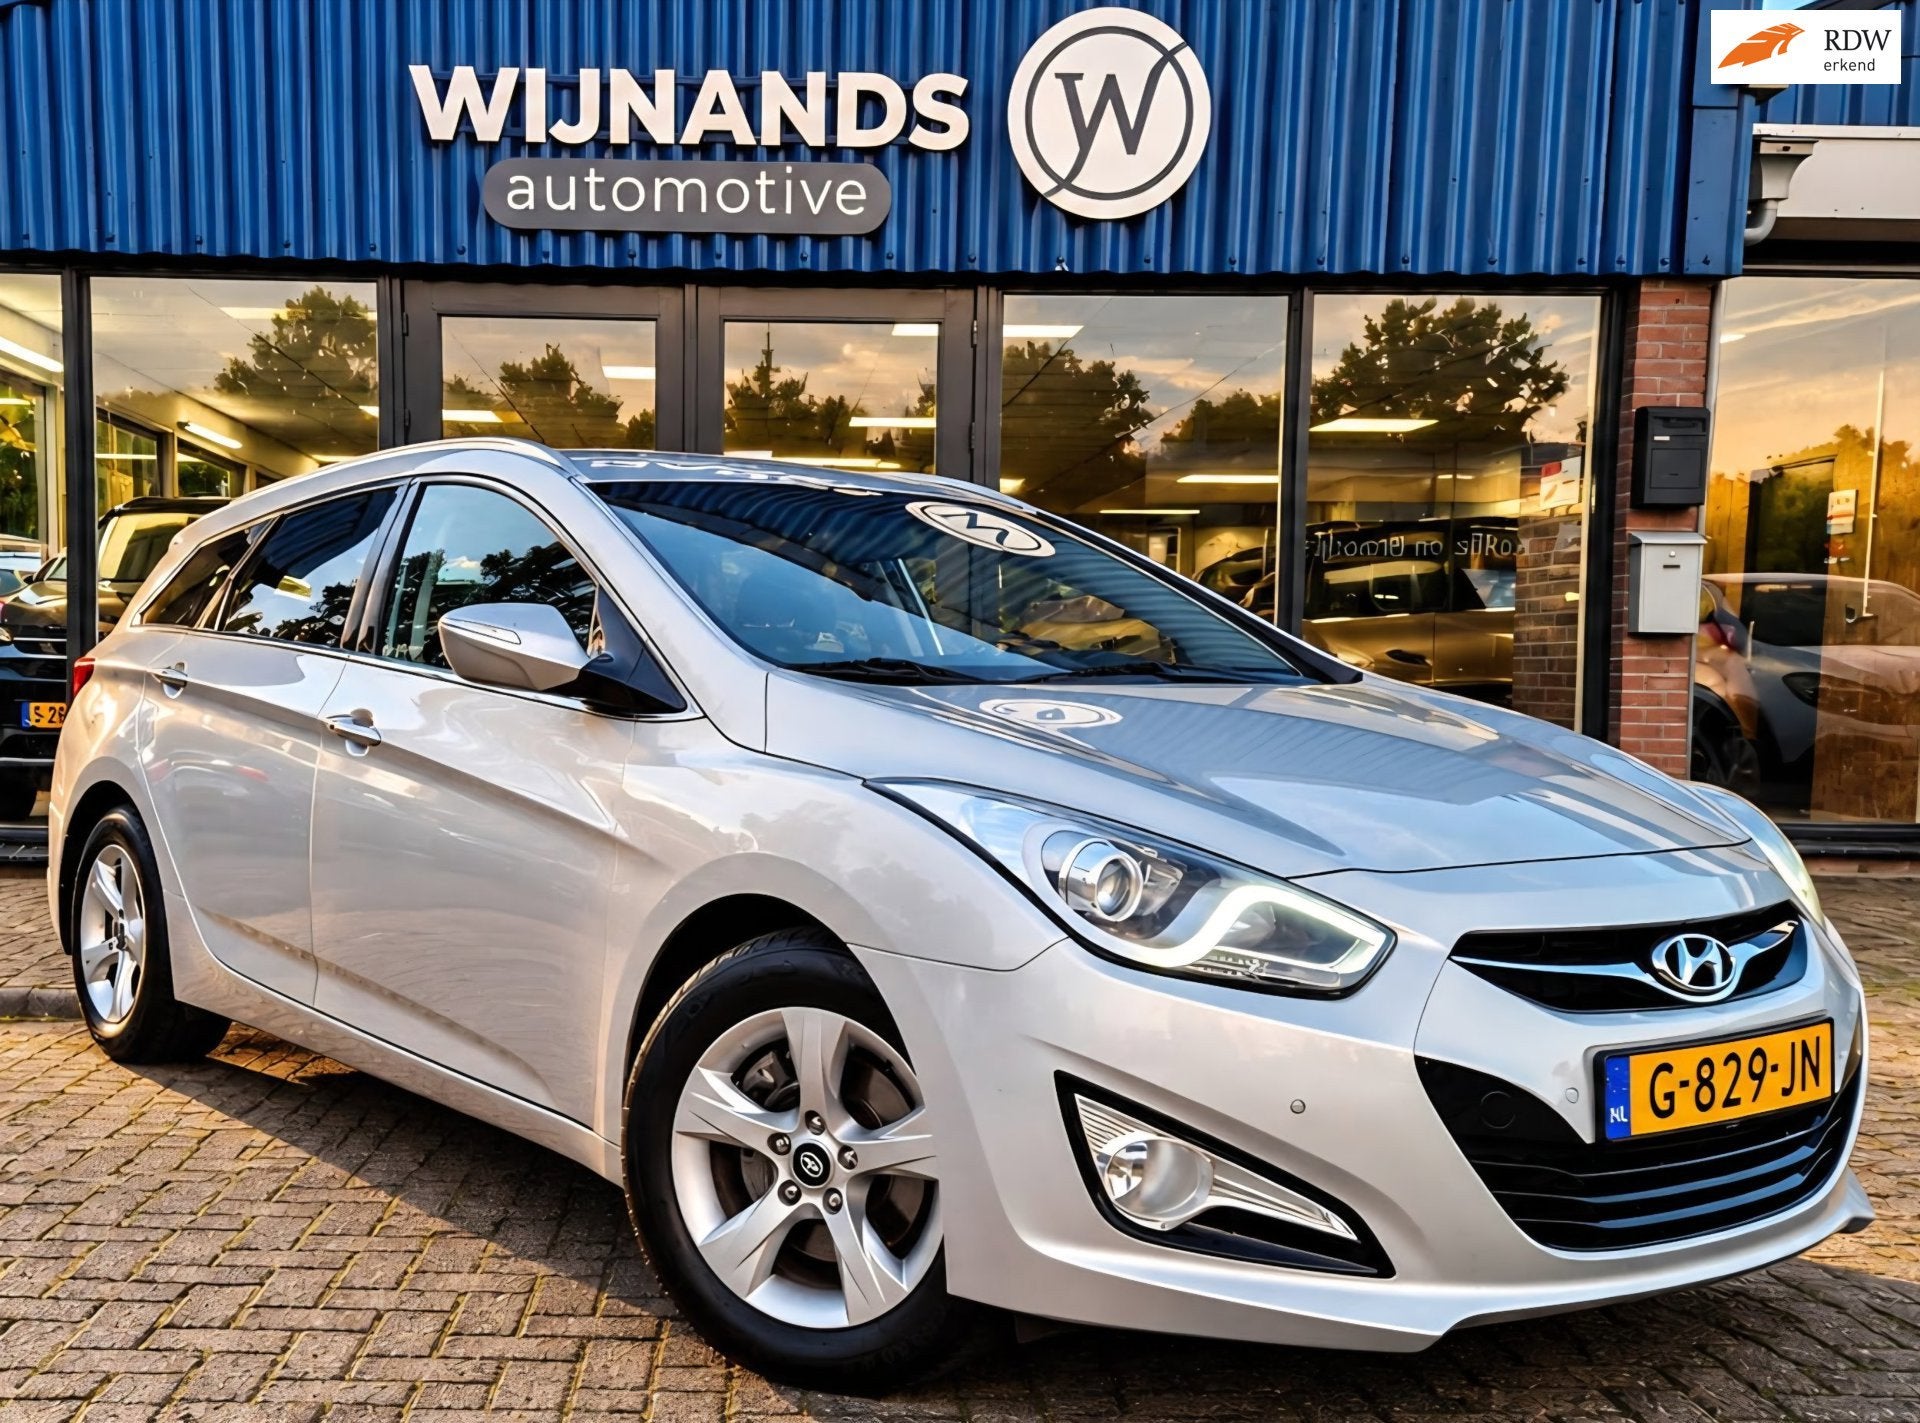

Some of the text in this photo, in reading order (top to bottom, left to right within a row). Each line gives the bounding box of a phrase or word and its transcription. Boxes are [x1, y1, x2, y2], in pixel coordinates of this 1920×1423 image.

[408, 65, 970, 151] WIJNANDS
[506, 166, 868, 217] automotive
[1649, 1035, 1821, 1119] G-829-JN
[1609, 1105, 1629, 1124] NL
